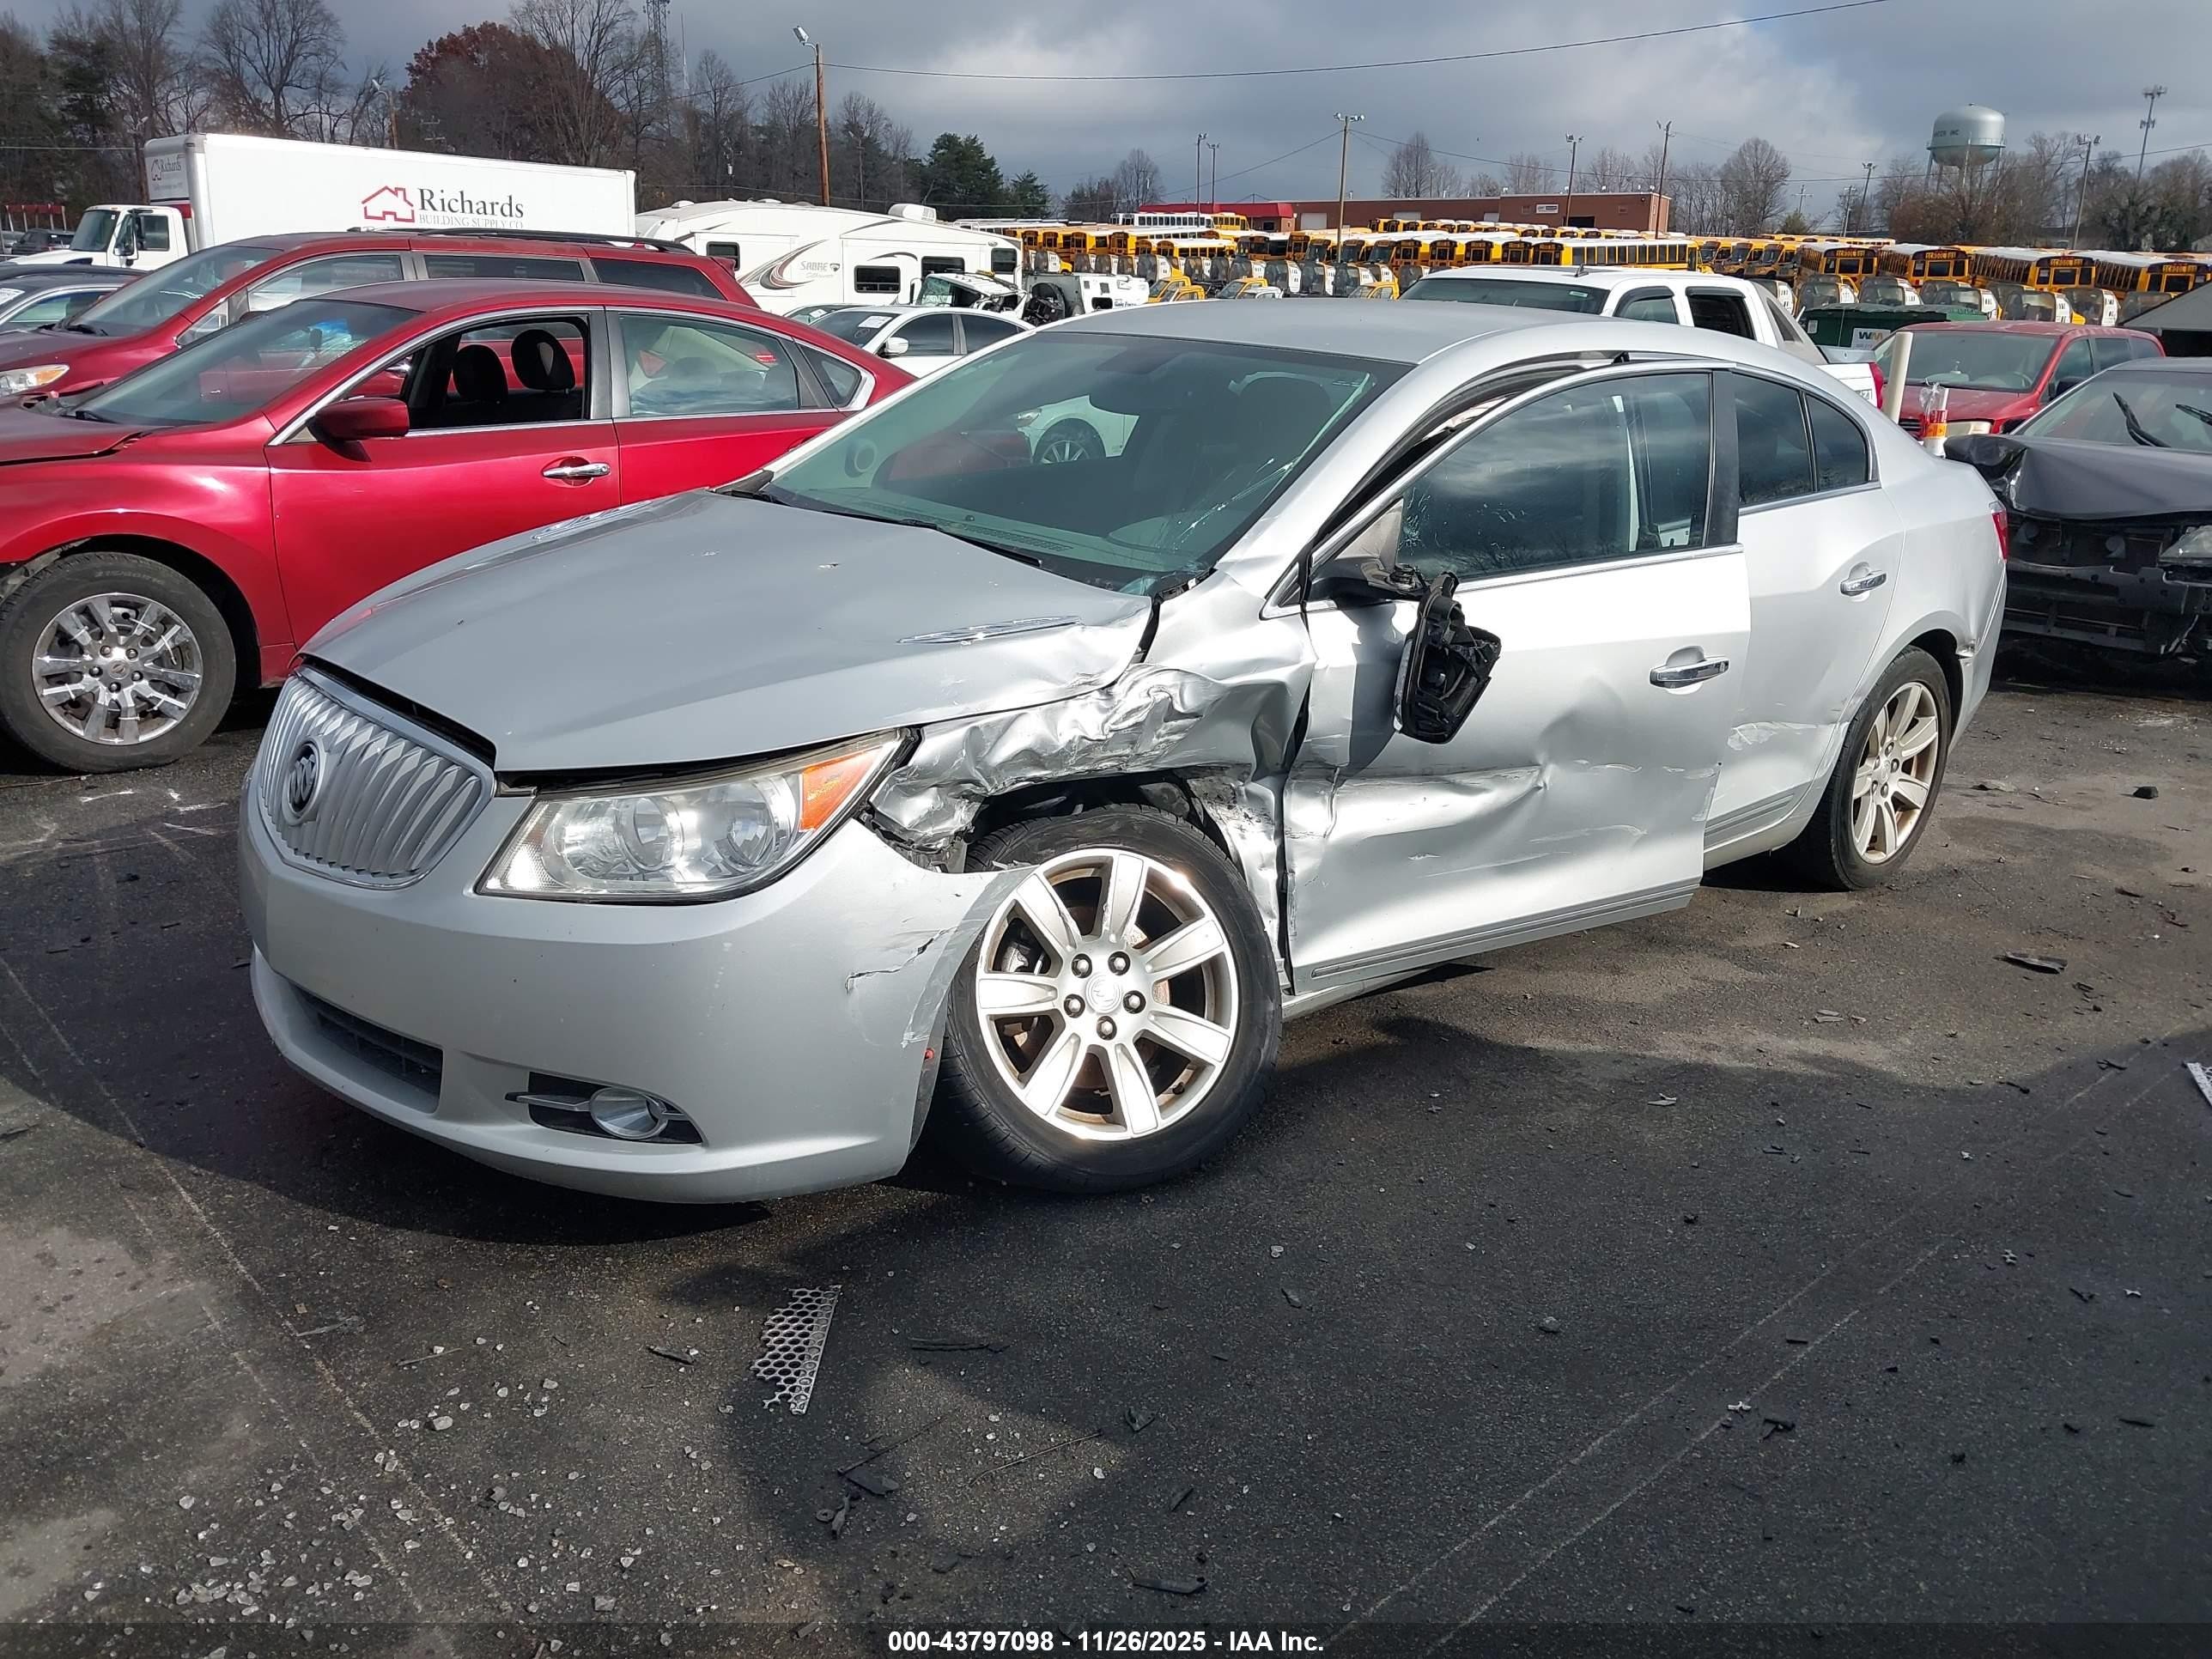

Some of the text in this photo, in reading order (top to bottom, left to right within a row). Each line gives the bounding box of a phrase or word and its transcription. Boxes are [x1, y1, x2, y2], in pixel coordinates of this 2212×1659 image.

[418, 188, 524, 218] Richards
[419, 214, 470, 228] BUILDING
[471, 217, 507, 228] SUPPLY
[1858, 331, 1883, 340] WM
